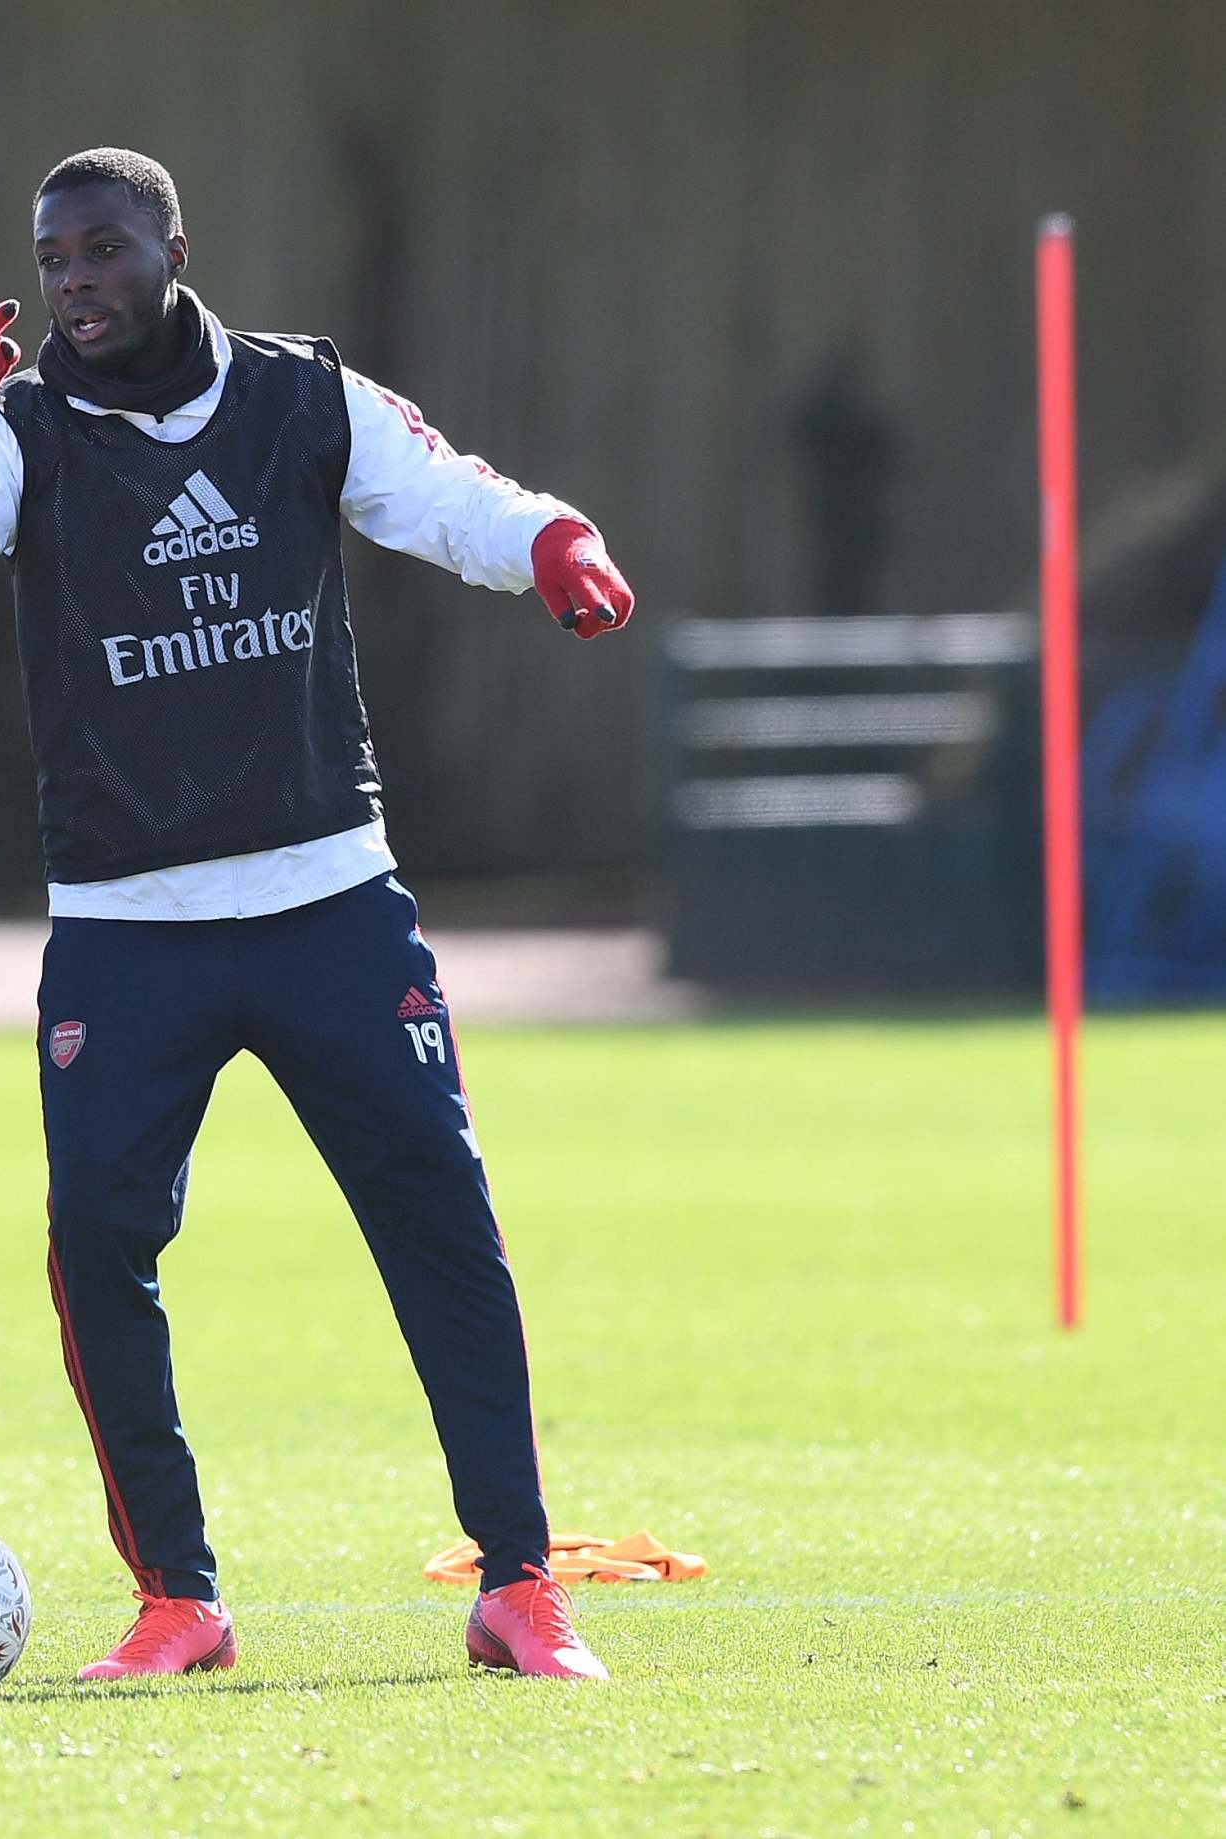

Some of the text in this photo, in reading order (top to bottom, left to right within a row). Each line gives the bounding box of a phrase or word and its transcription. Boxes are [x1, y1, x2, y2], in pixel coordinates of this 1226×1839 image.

[143, 522, 259, 566] adidas
[179, 573, 239, 610] Fly
[101, 607, 314, 686] Emirates
[404, 1021, 445, 1064] 19
